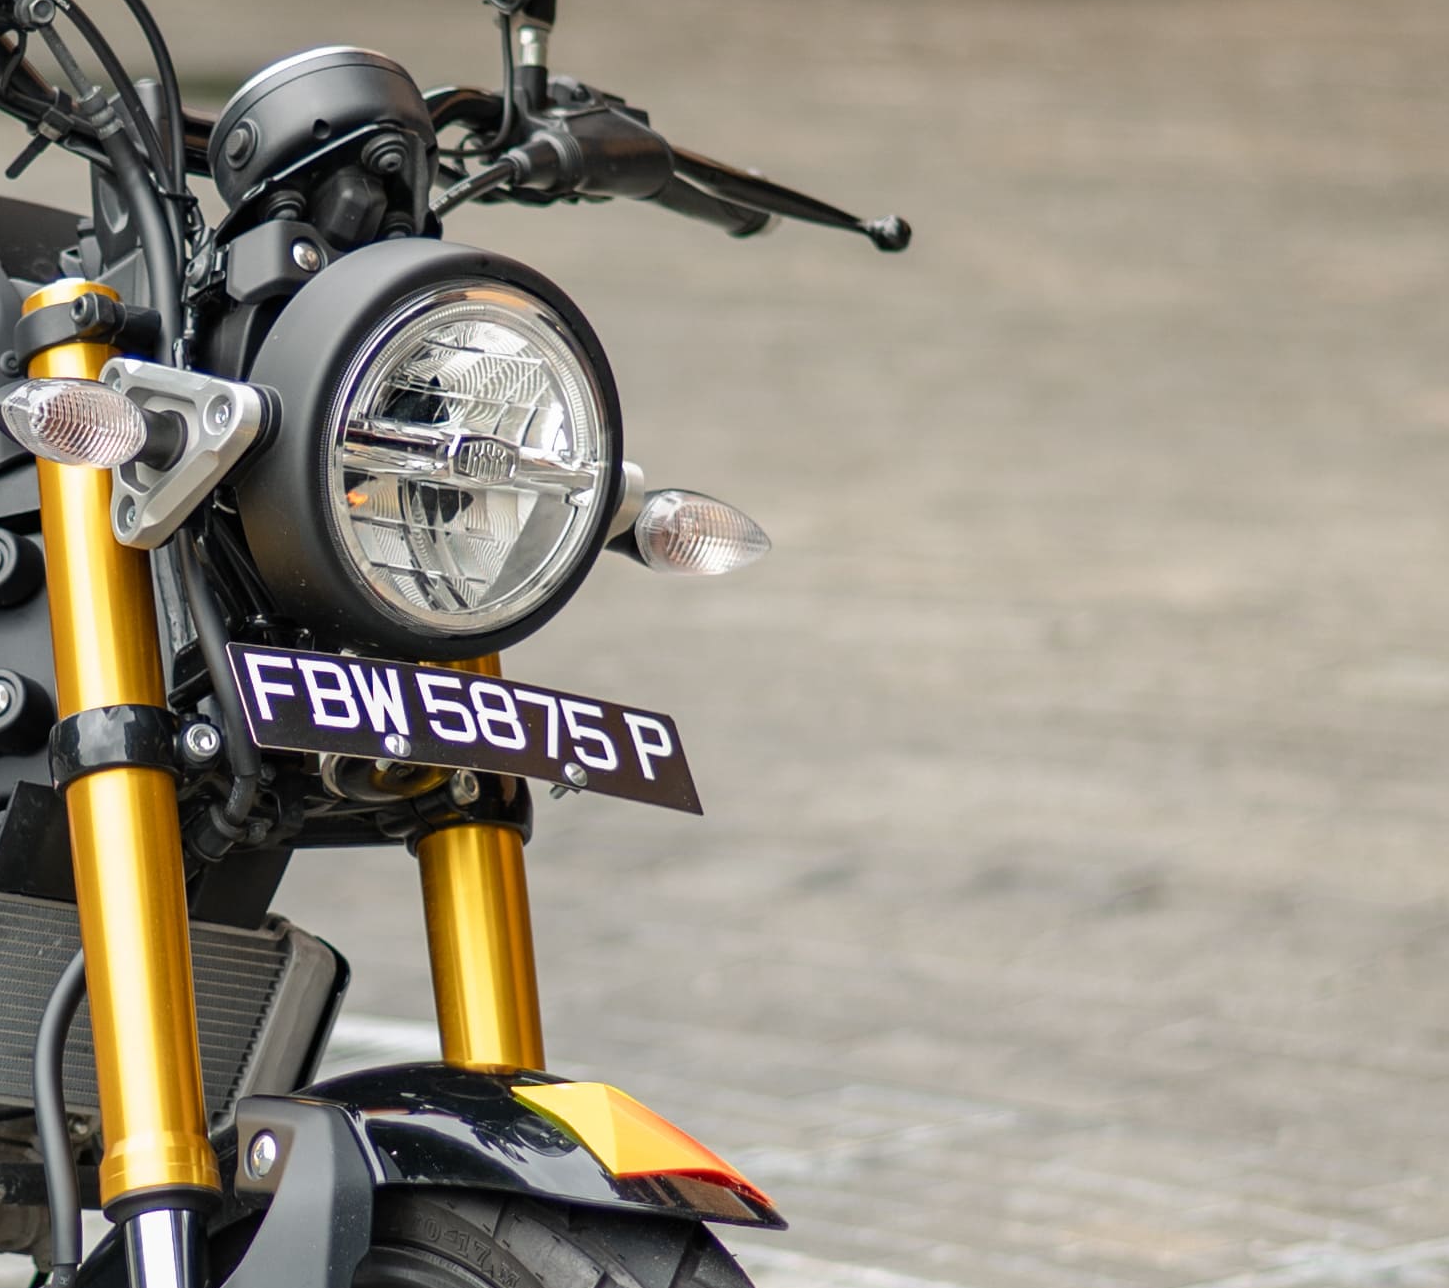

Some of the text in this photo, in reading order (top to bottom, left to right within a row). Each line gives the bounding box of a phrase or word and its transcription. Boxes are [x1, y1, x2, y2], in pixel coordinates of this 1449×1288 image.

[243, 652, 673, 780] FBW 5875 P
